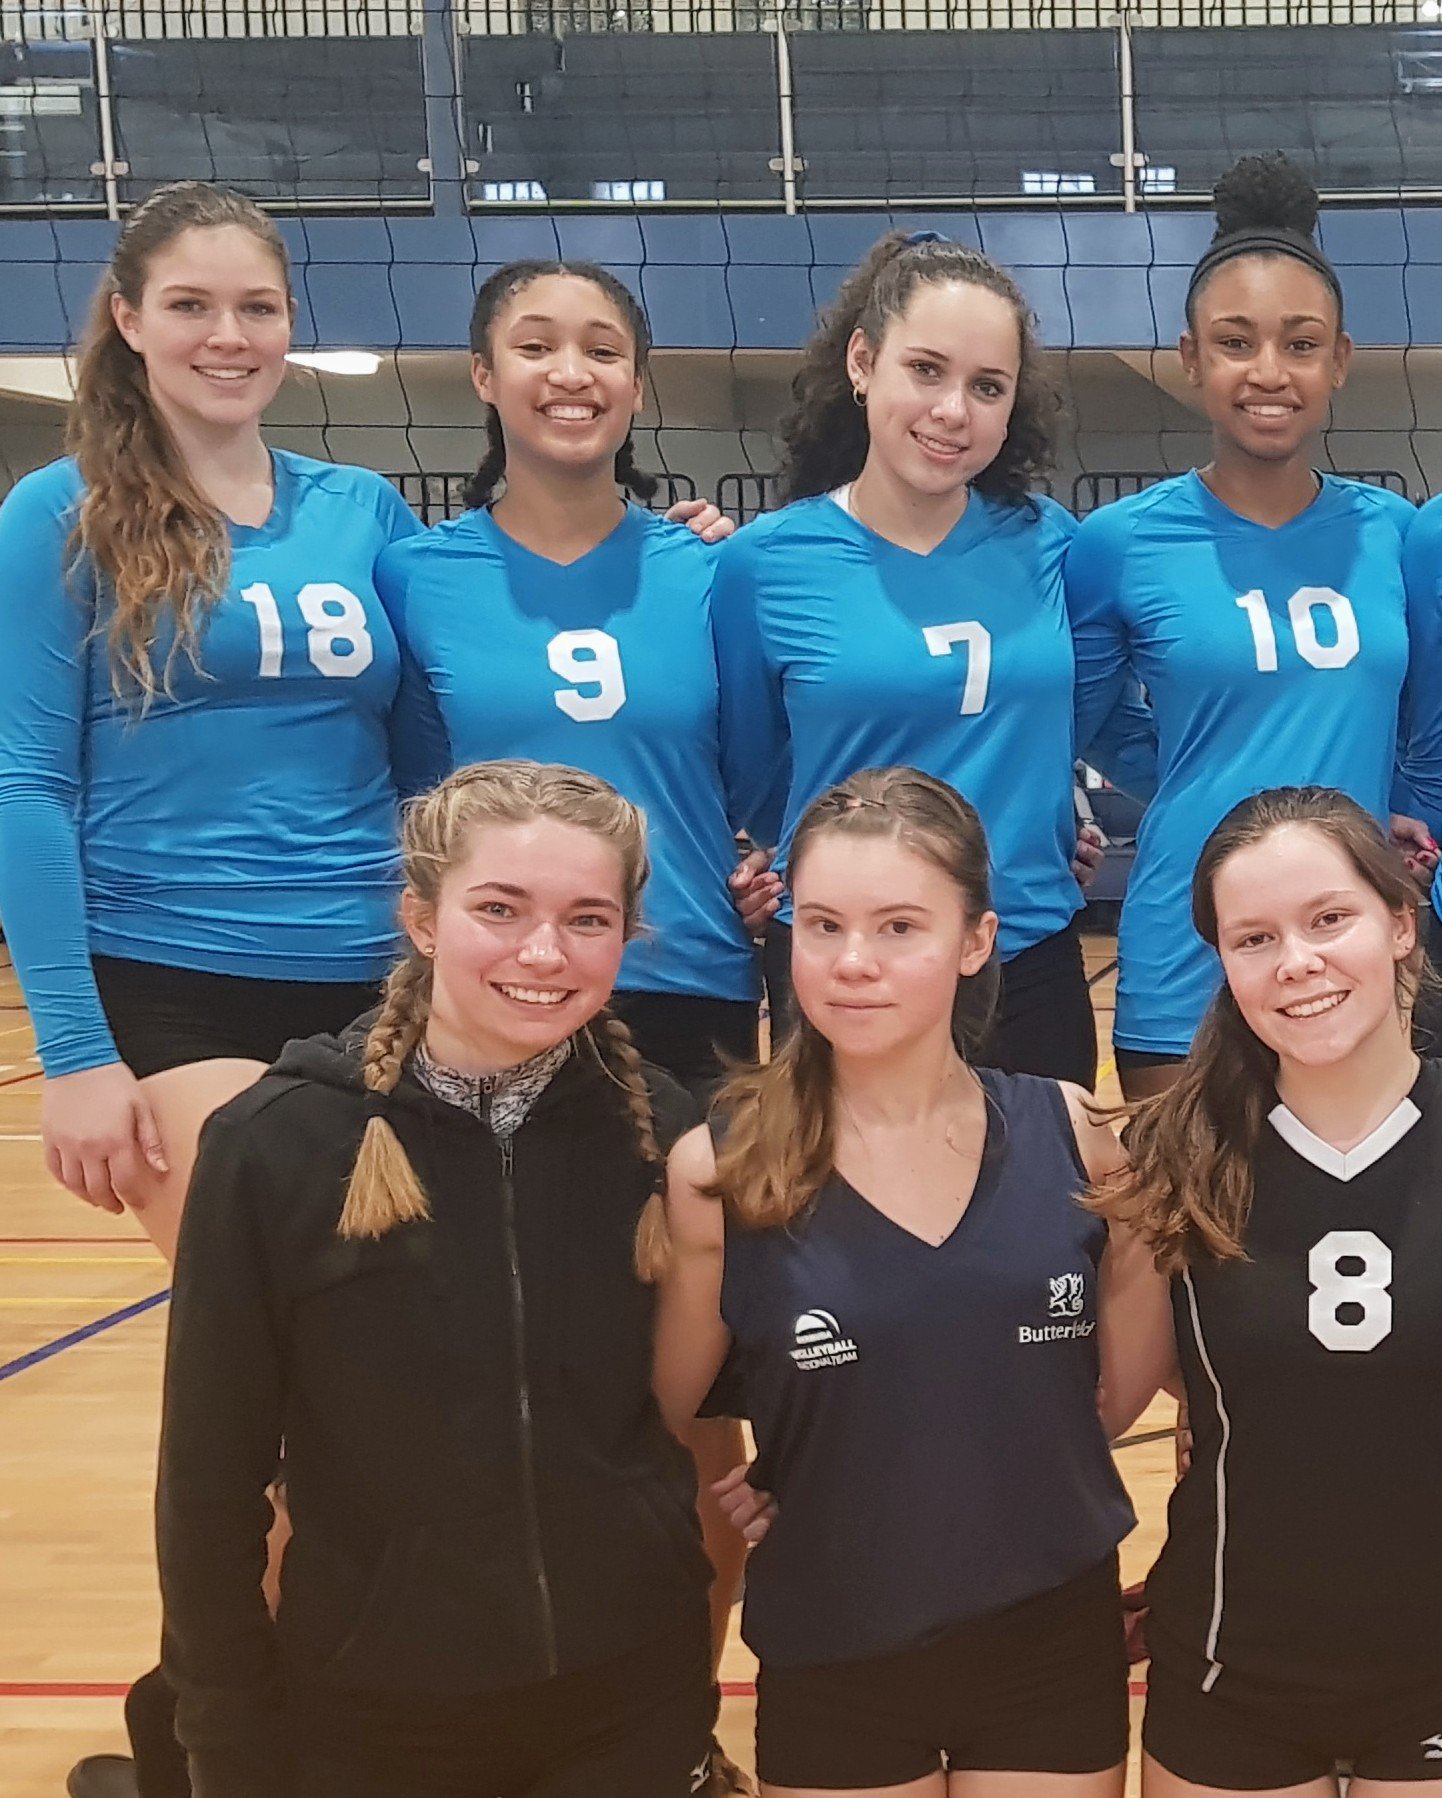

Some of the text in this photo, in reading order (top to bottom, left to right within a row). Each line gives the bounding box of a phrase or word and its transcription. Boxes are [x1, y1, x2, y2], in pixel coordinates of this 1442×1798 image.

[240, 582, 373, 680] 18
[546, 628, 627, 722] 9
[921, 620, 991, 715] 7
[1235, 586, 1360, 672] 10
[1308, 1230, 1392, 1352] 8
